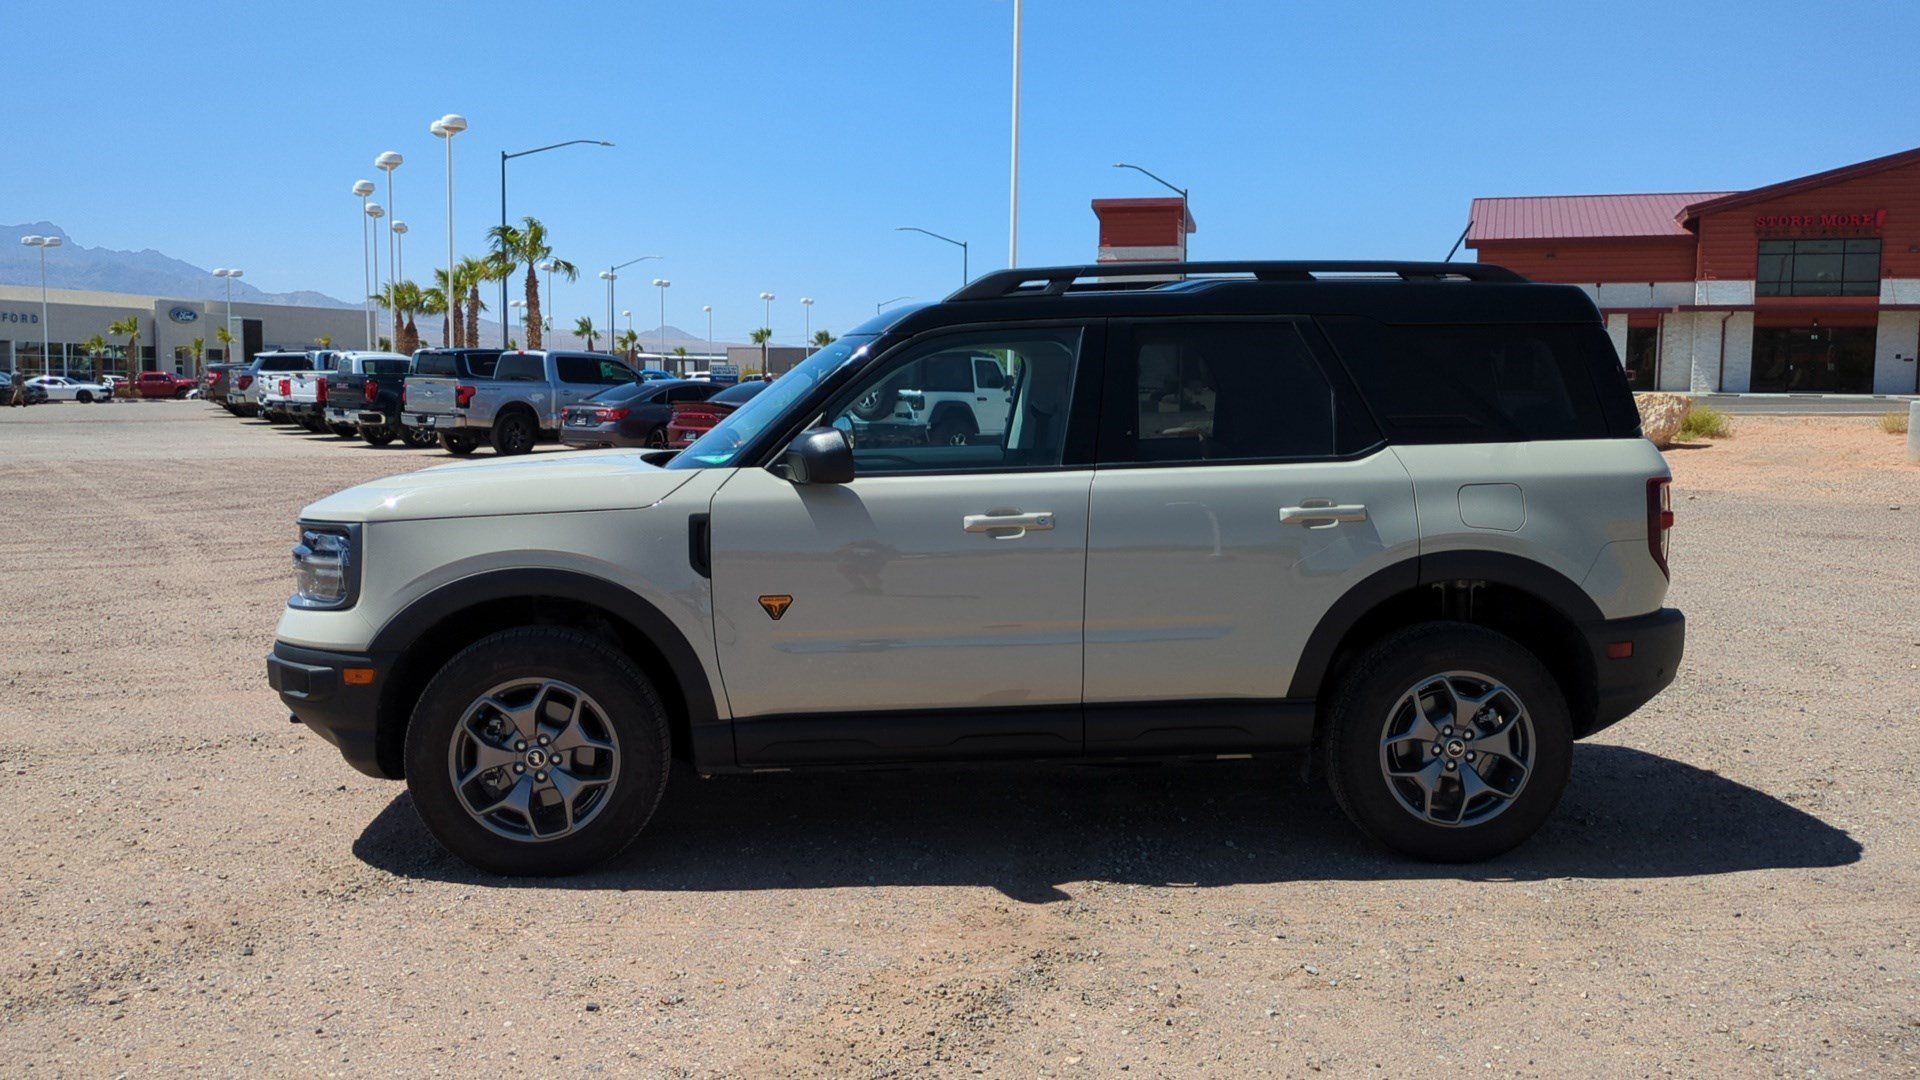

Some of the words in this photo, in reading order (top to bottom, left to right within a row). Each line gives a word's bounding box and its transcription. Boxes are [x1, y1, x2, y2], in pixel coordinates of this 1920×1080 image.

[1755, 215, 1816, 227] STORE
[2, 313, 39, 324] FORD
[174, 311, 195, 321] Ford
